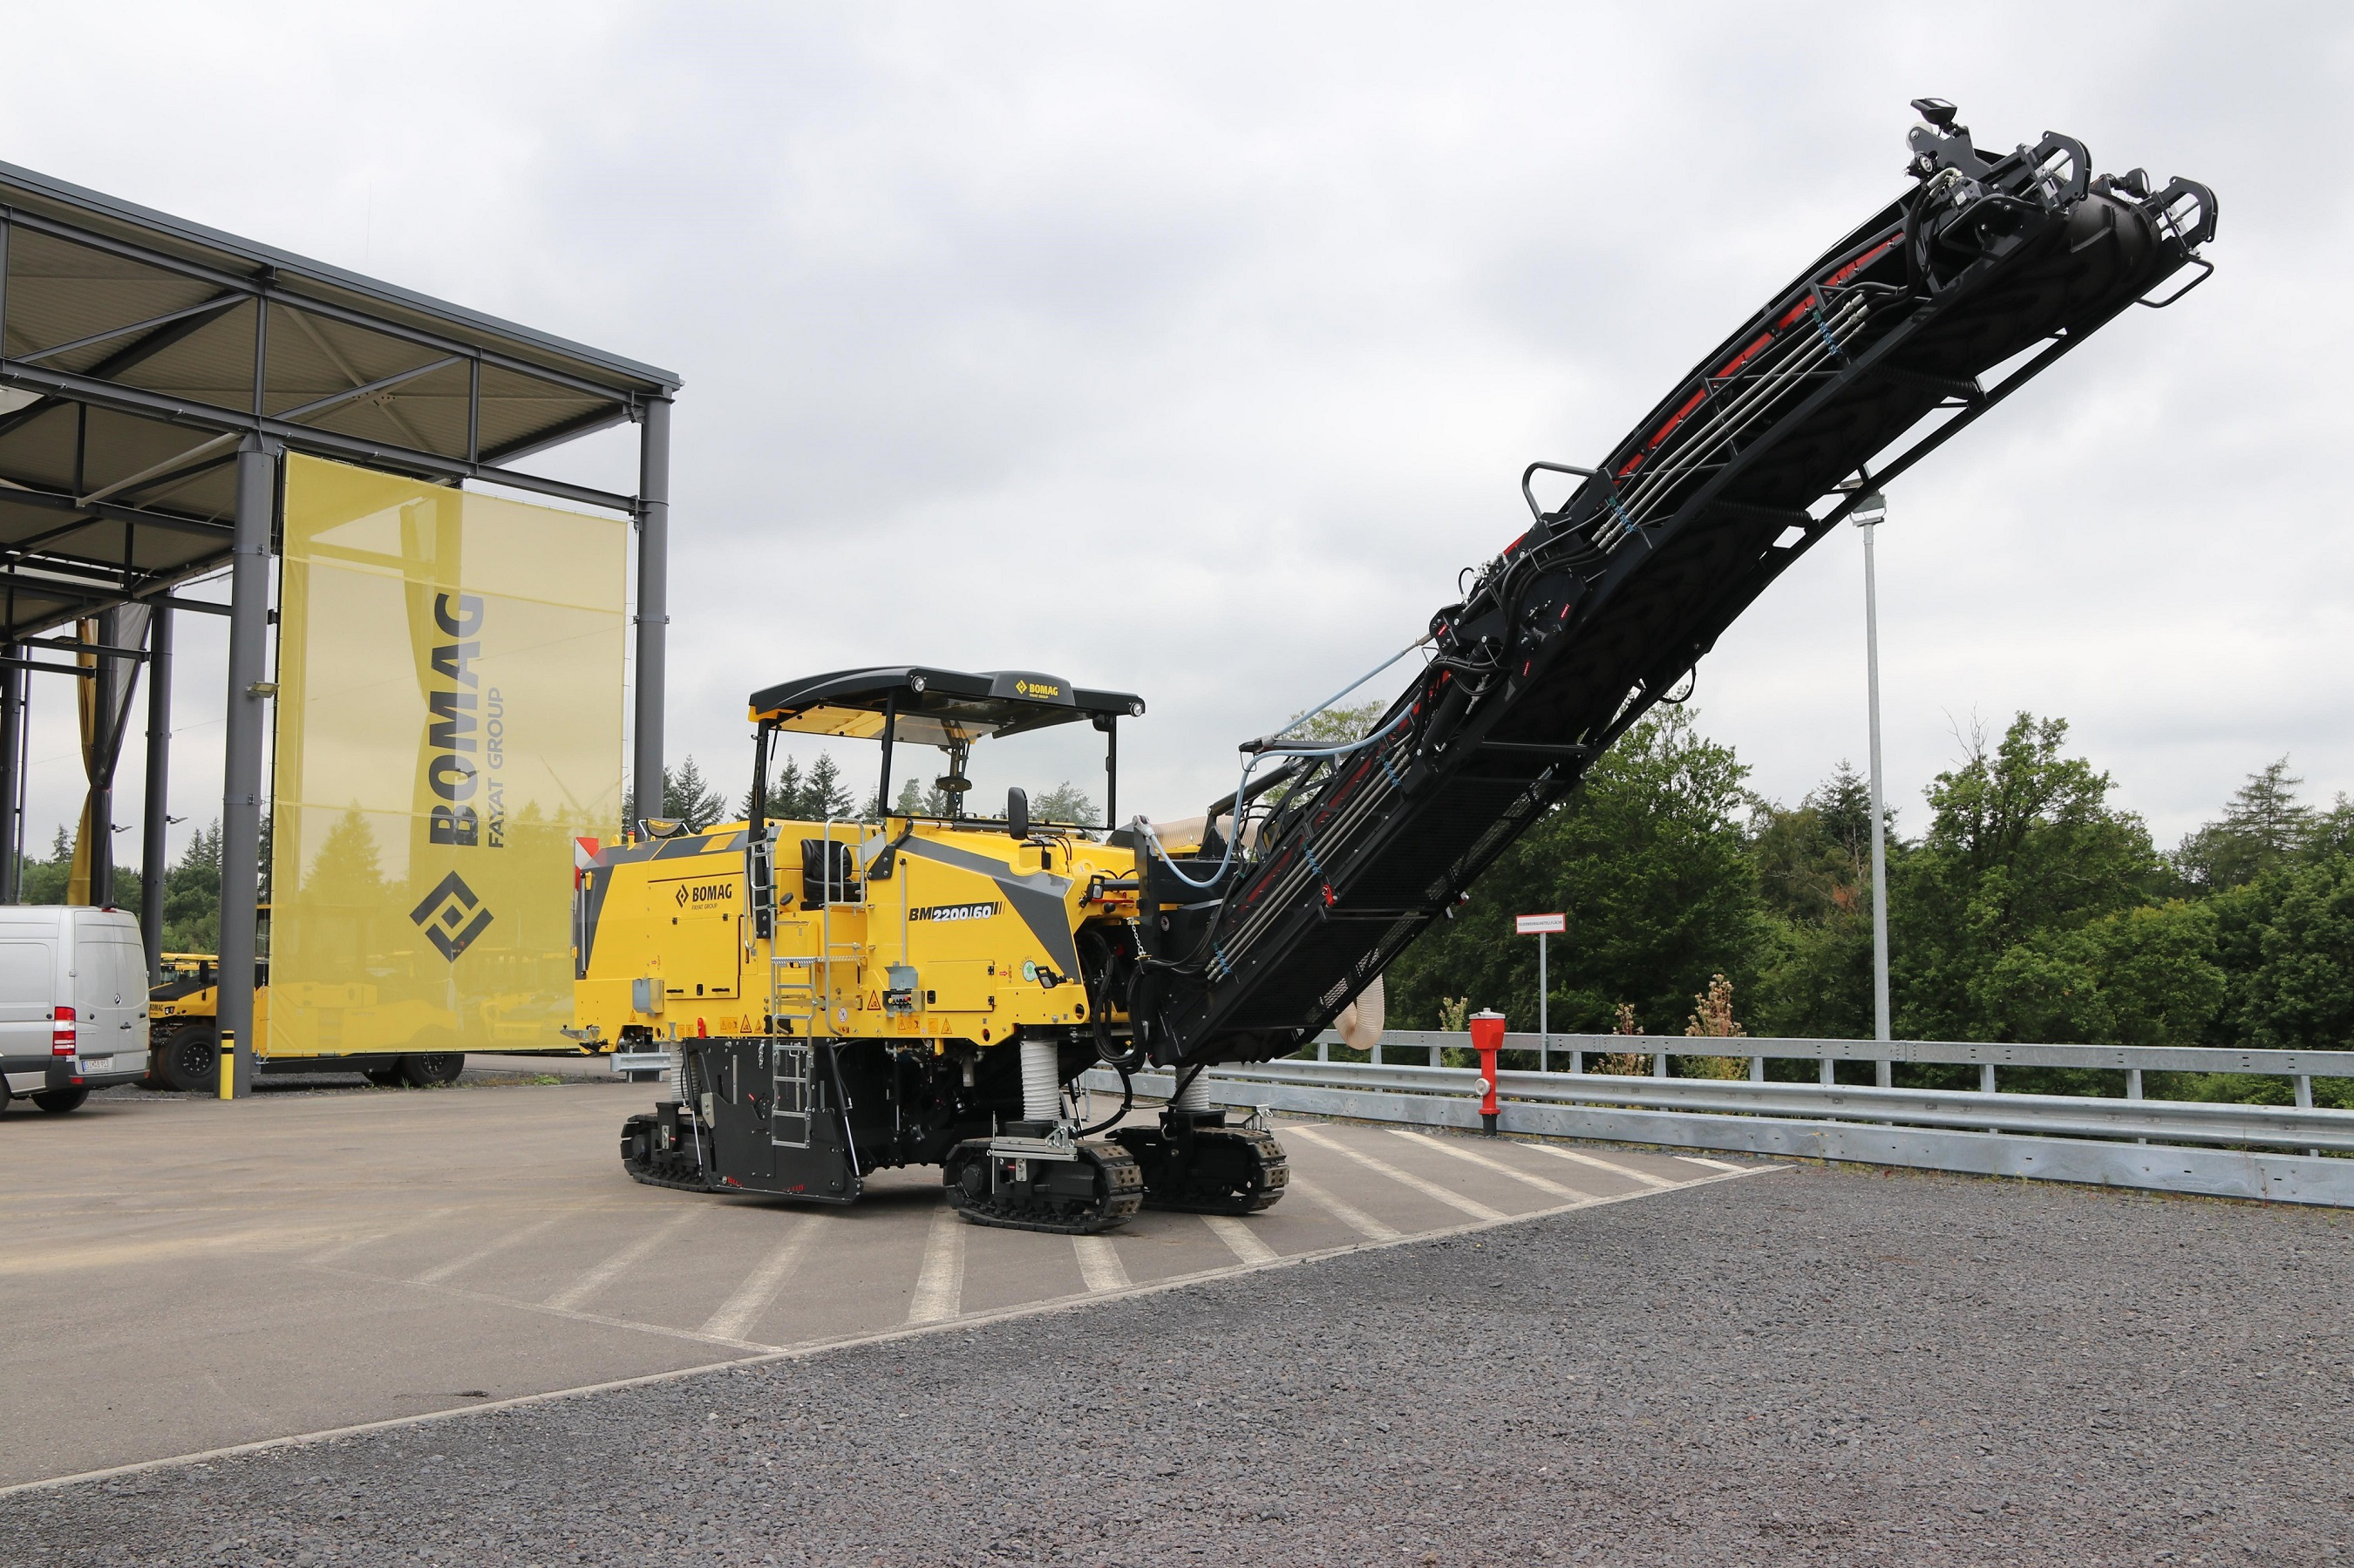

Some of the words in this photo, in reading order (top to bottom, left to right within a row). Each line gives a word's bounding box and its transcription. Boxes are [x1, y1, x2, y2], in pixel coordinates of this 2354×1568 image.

[429, 593, 484, 846] BOMAG
[1030, 683, 1058, 696] BOMAG
[487, 687, 504, 770] GROUP
[488, 777, 504, 848] FAYAT
[692, 883, 732, 902] BOMAG
